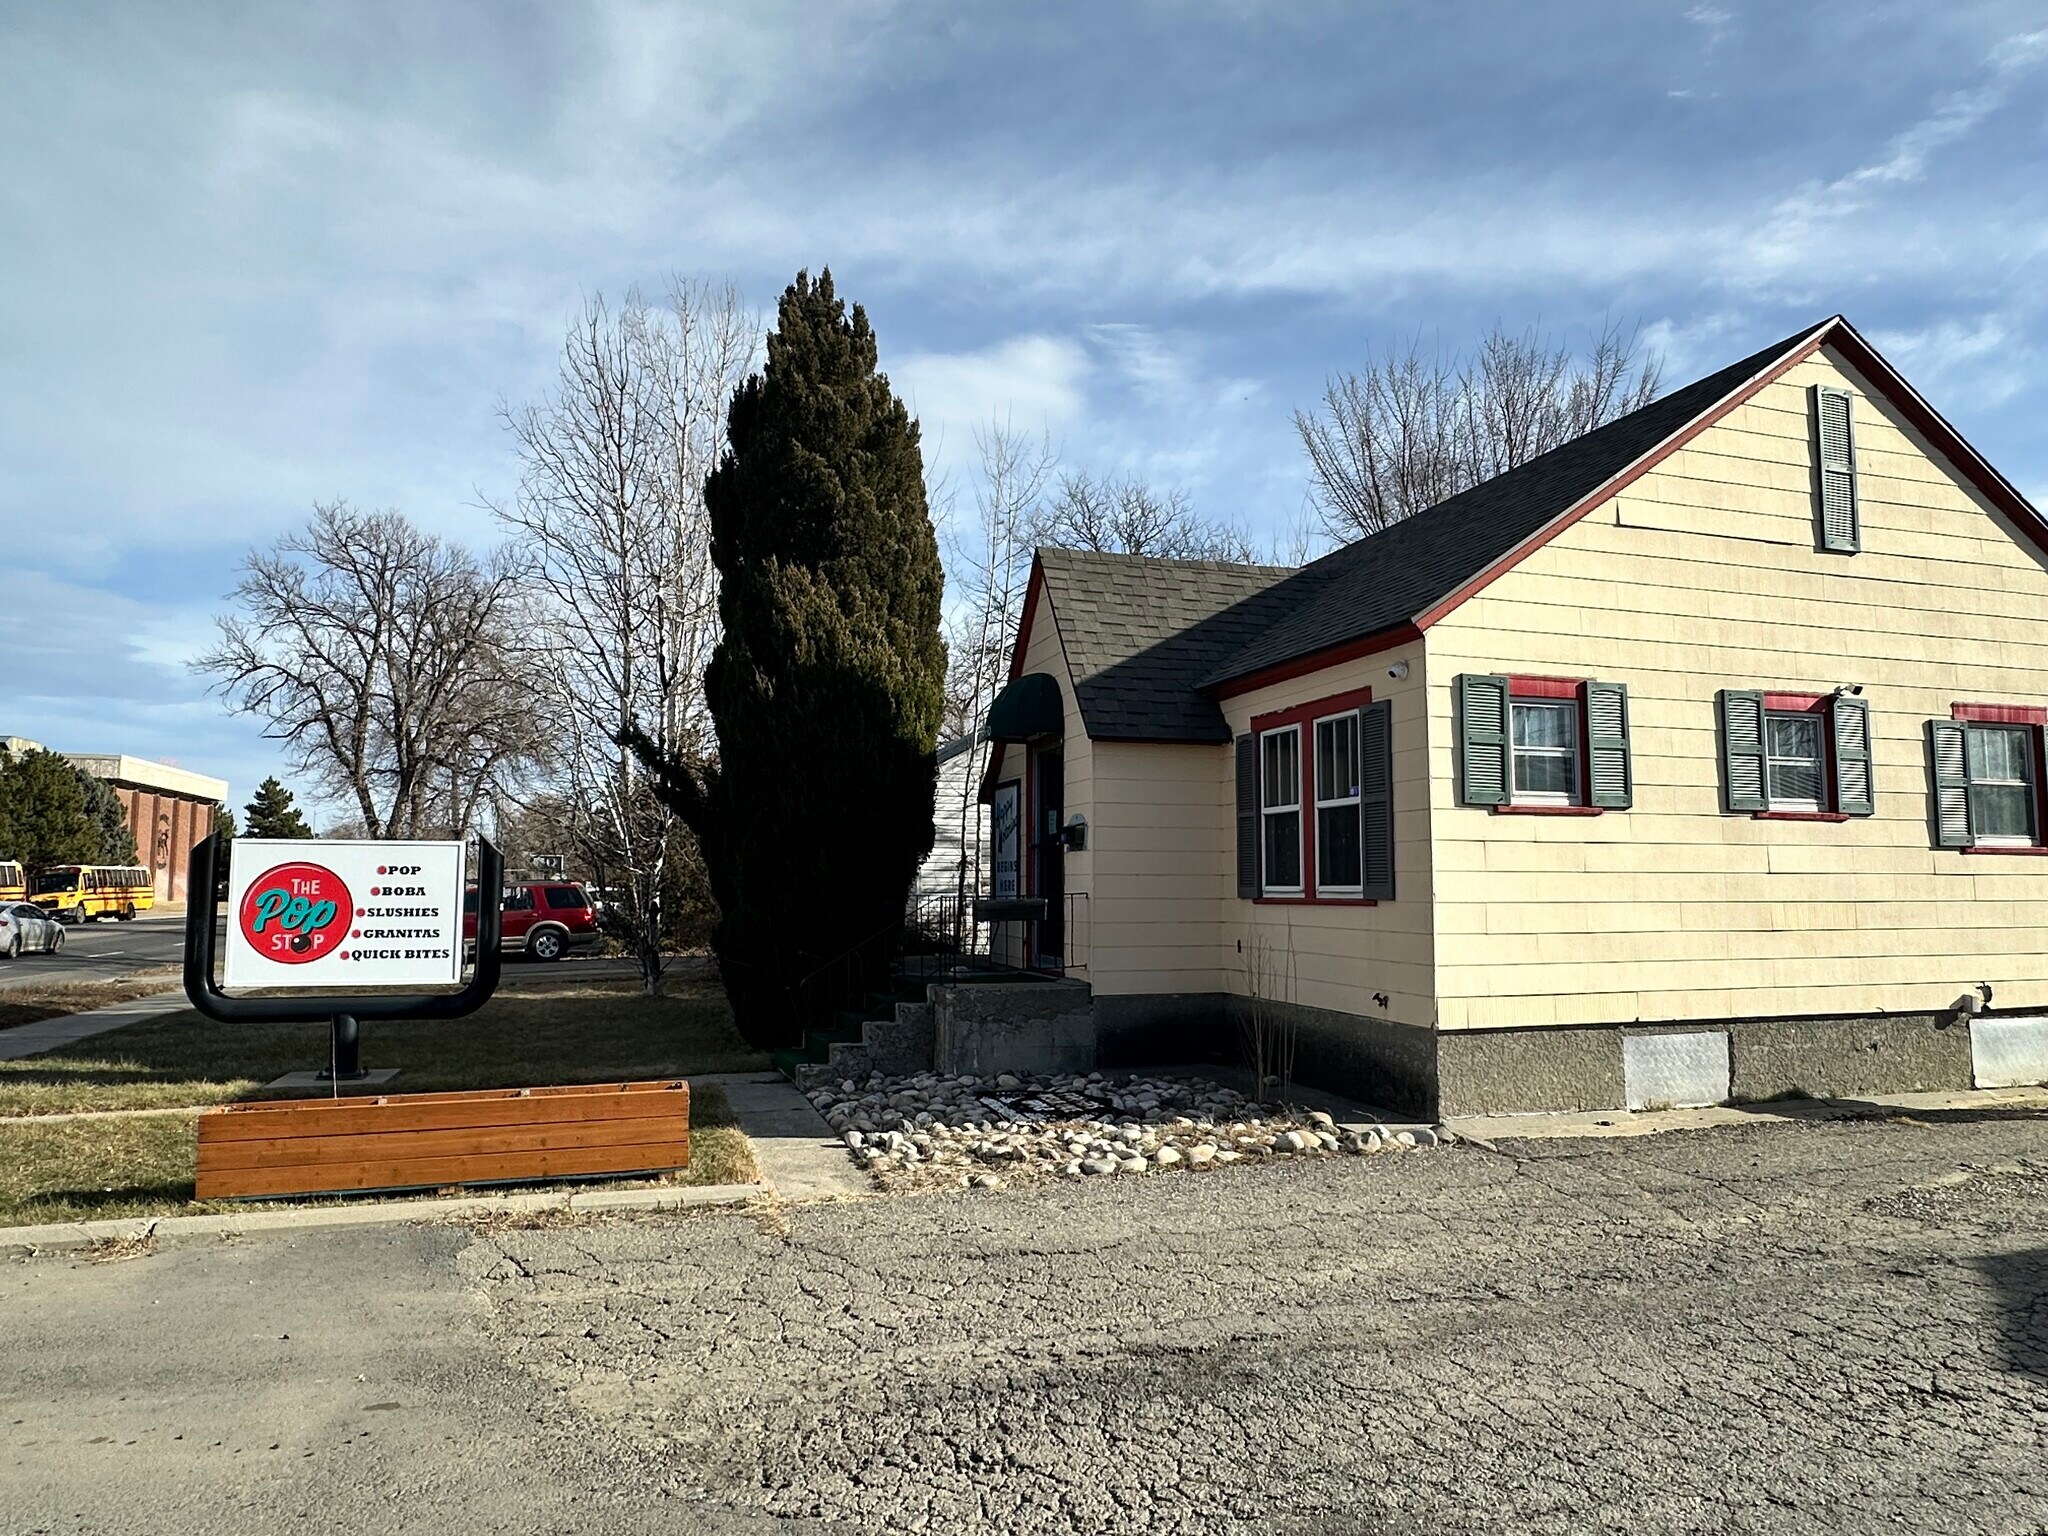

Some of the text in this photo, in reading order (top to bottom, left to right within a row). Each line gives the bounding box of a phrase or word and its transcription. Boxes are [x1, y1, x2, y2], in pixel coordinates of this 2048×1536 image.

[388, 865, 422, 876] POP
[996, 860, 1017, 873] BEGINS
[291, 878, 320, 895] THE
[381, 886, 426, 897] BOBA
[1000, 879, 1015, 892] HERE
[252, 888, 338, 935] Pop
[367, 907, 439, 918] SLUSHIES
[363, 928, 441, 939] GRANITAS
[271, 934, 325, 954] STOP
[351, 949, 450, 962] QUICK BITES
